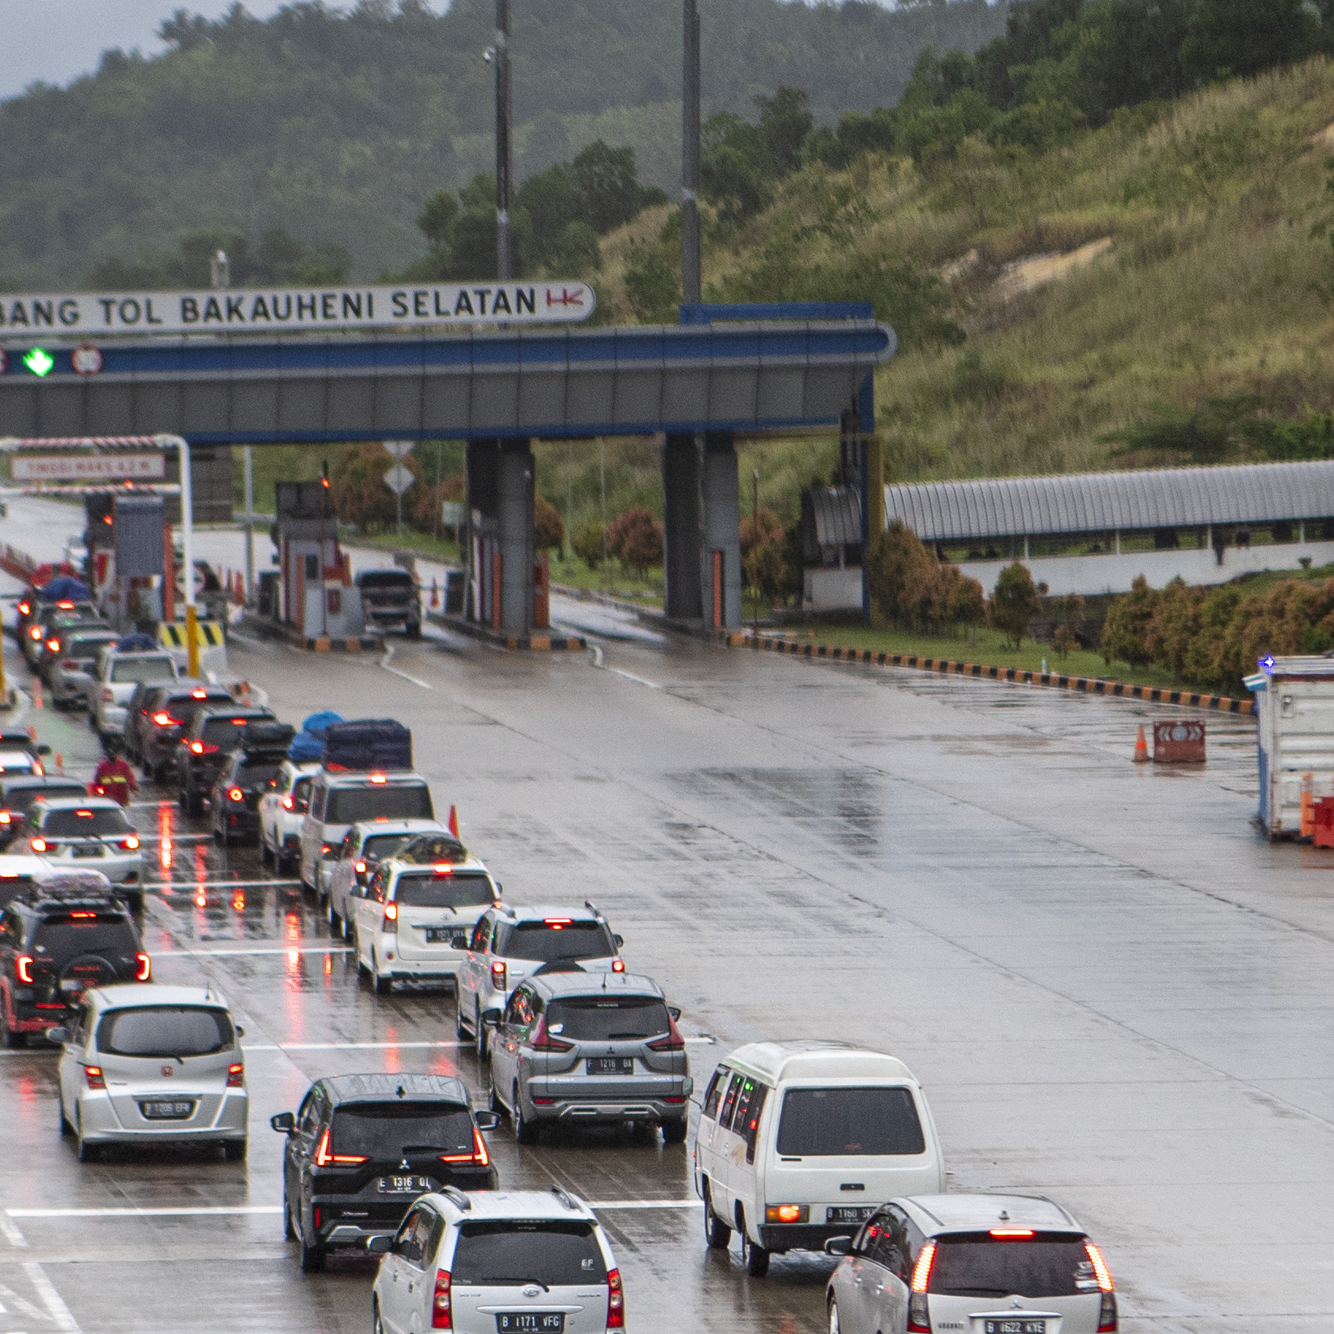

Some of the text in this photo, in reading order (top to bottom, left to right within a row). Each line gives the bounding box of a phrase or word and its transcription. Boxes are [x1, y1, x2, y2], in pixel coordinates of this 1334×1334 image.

[98, 297, 163, 325] TOL
[180, 292, 374, 324] BAKAUHENI
[392, 287, 537, 318] SELATAN
[394, 1176, 413, 1187] 1316
[502, 1315, 560, 1327] B 1171 VFG
[987, 1321, 995, 1333] B
[1000, 1321, 1022, 1333] 1622
